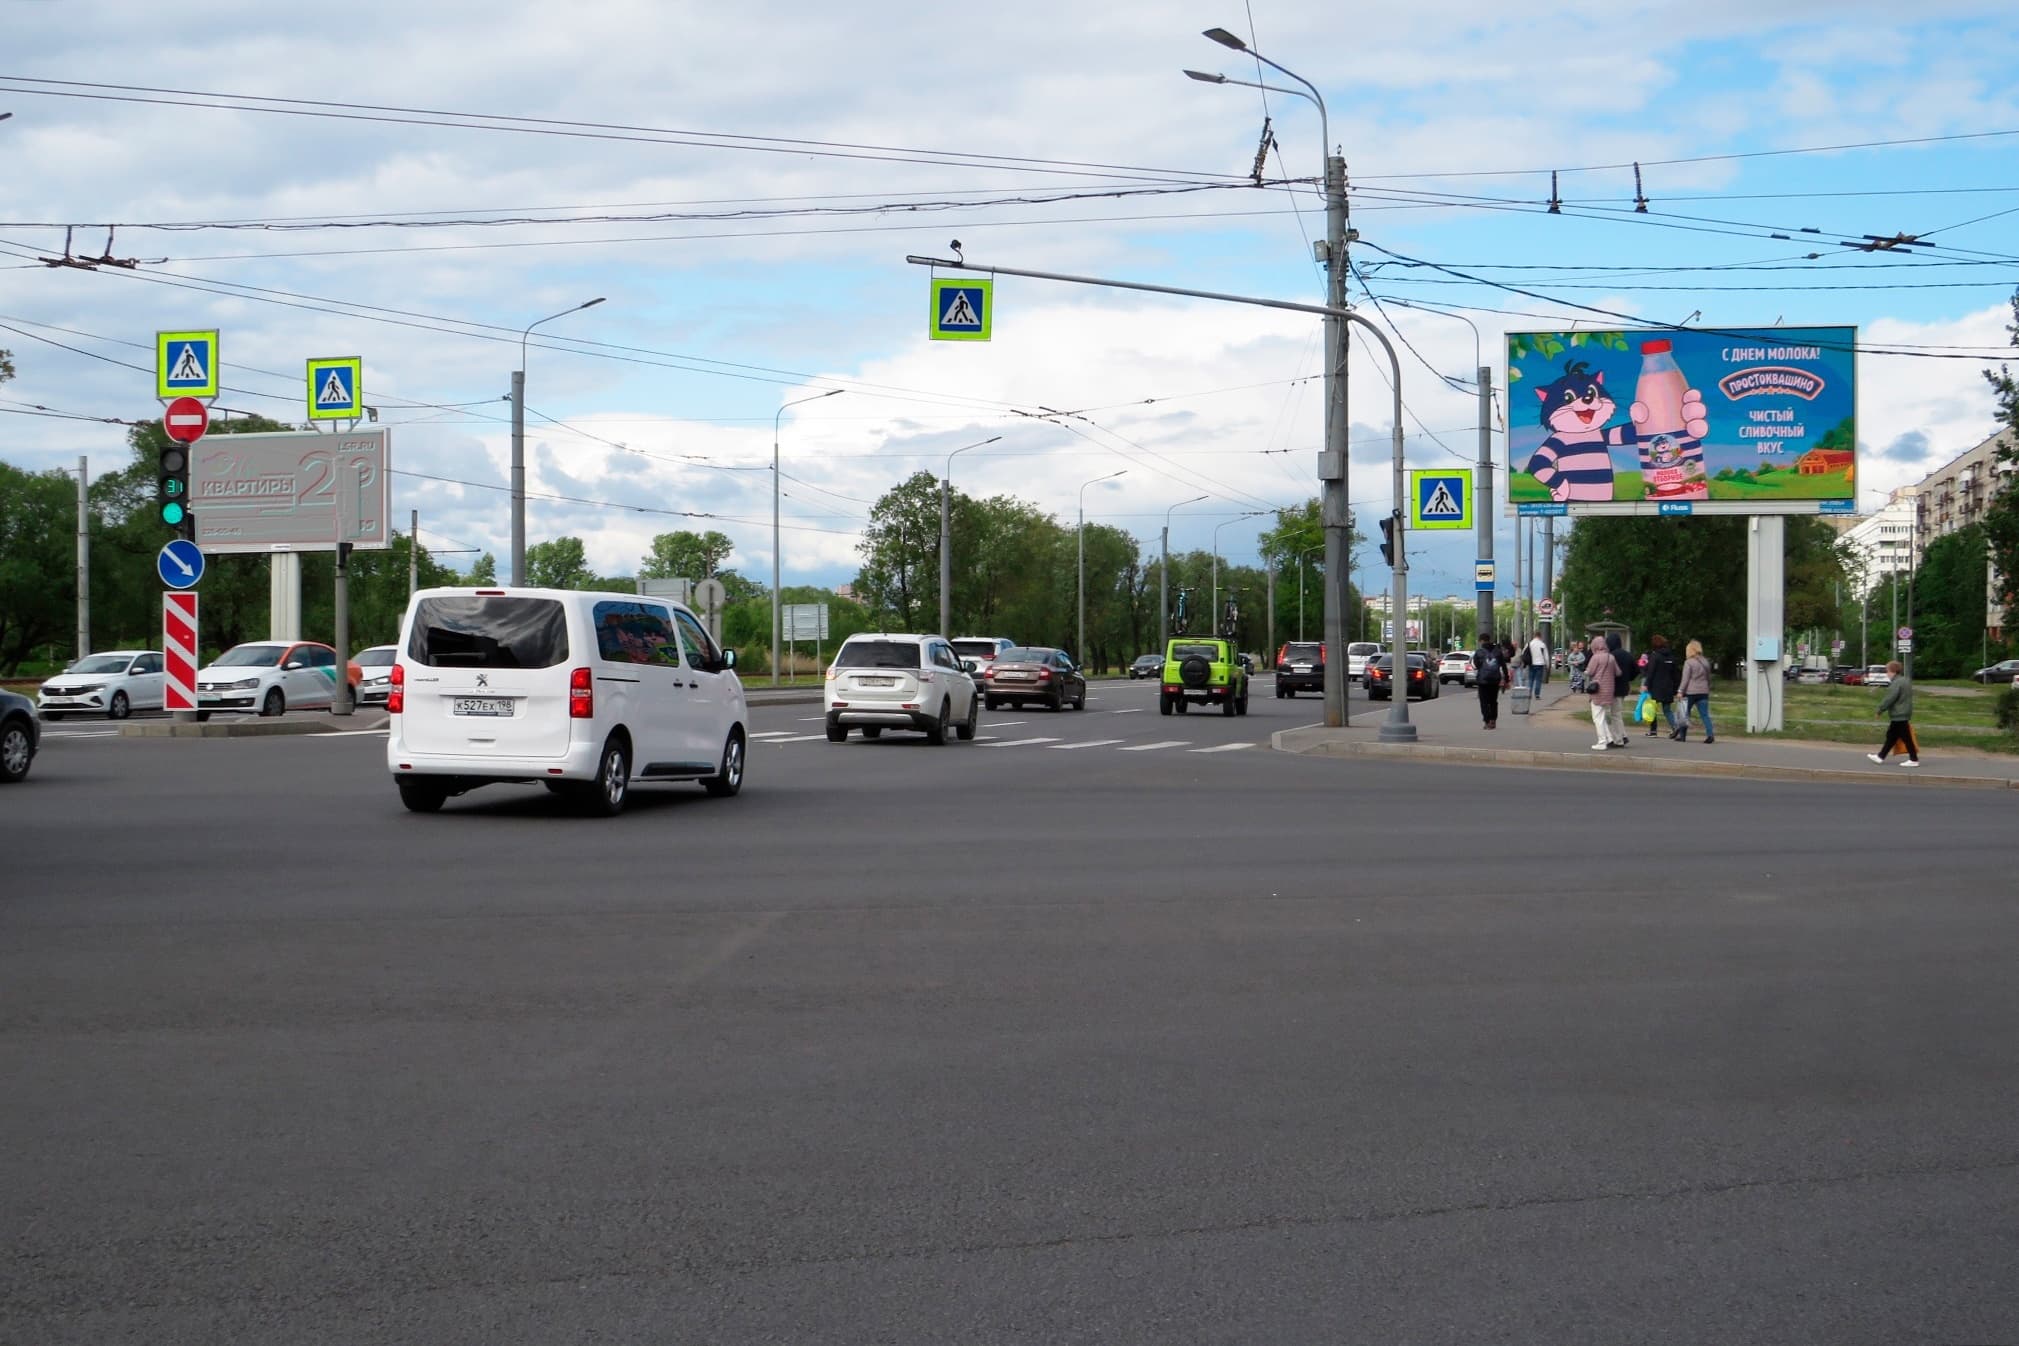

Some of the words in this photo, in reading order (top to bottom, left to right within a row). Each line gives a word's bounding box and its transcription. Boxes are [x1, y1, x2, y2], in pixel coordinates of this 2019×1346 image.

[1722, 348, 1729, 361] С
[1731, 348, 1765, 362] ДНЕМ
[1768, 347, 1820, 361] МОЛОКА!
[1729, 373, 1815, 393] ПРОСТОКВАШИНО
[1749, 407, 1794, 422] ЧИСТЫЙ
[1739, 423, 1805, 437] СЛИВОЧНЫЙ
[1757, 441, 1784, 454] ВКУС
[202, 479, 296, 496] КВАРТИРЫ
